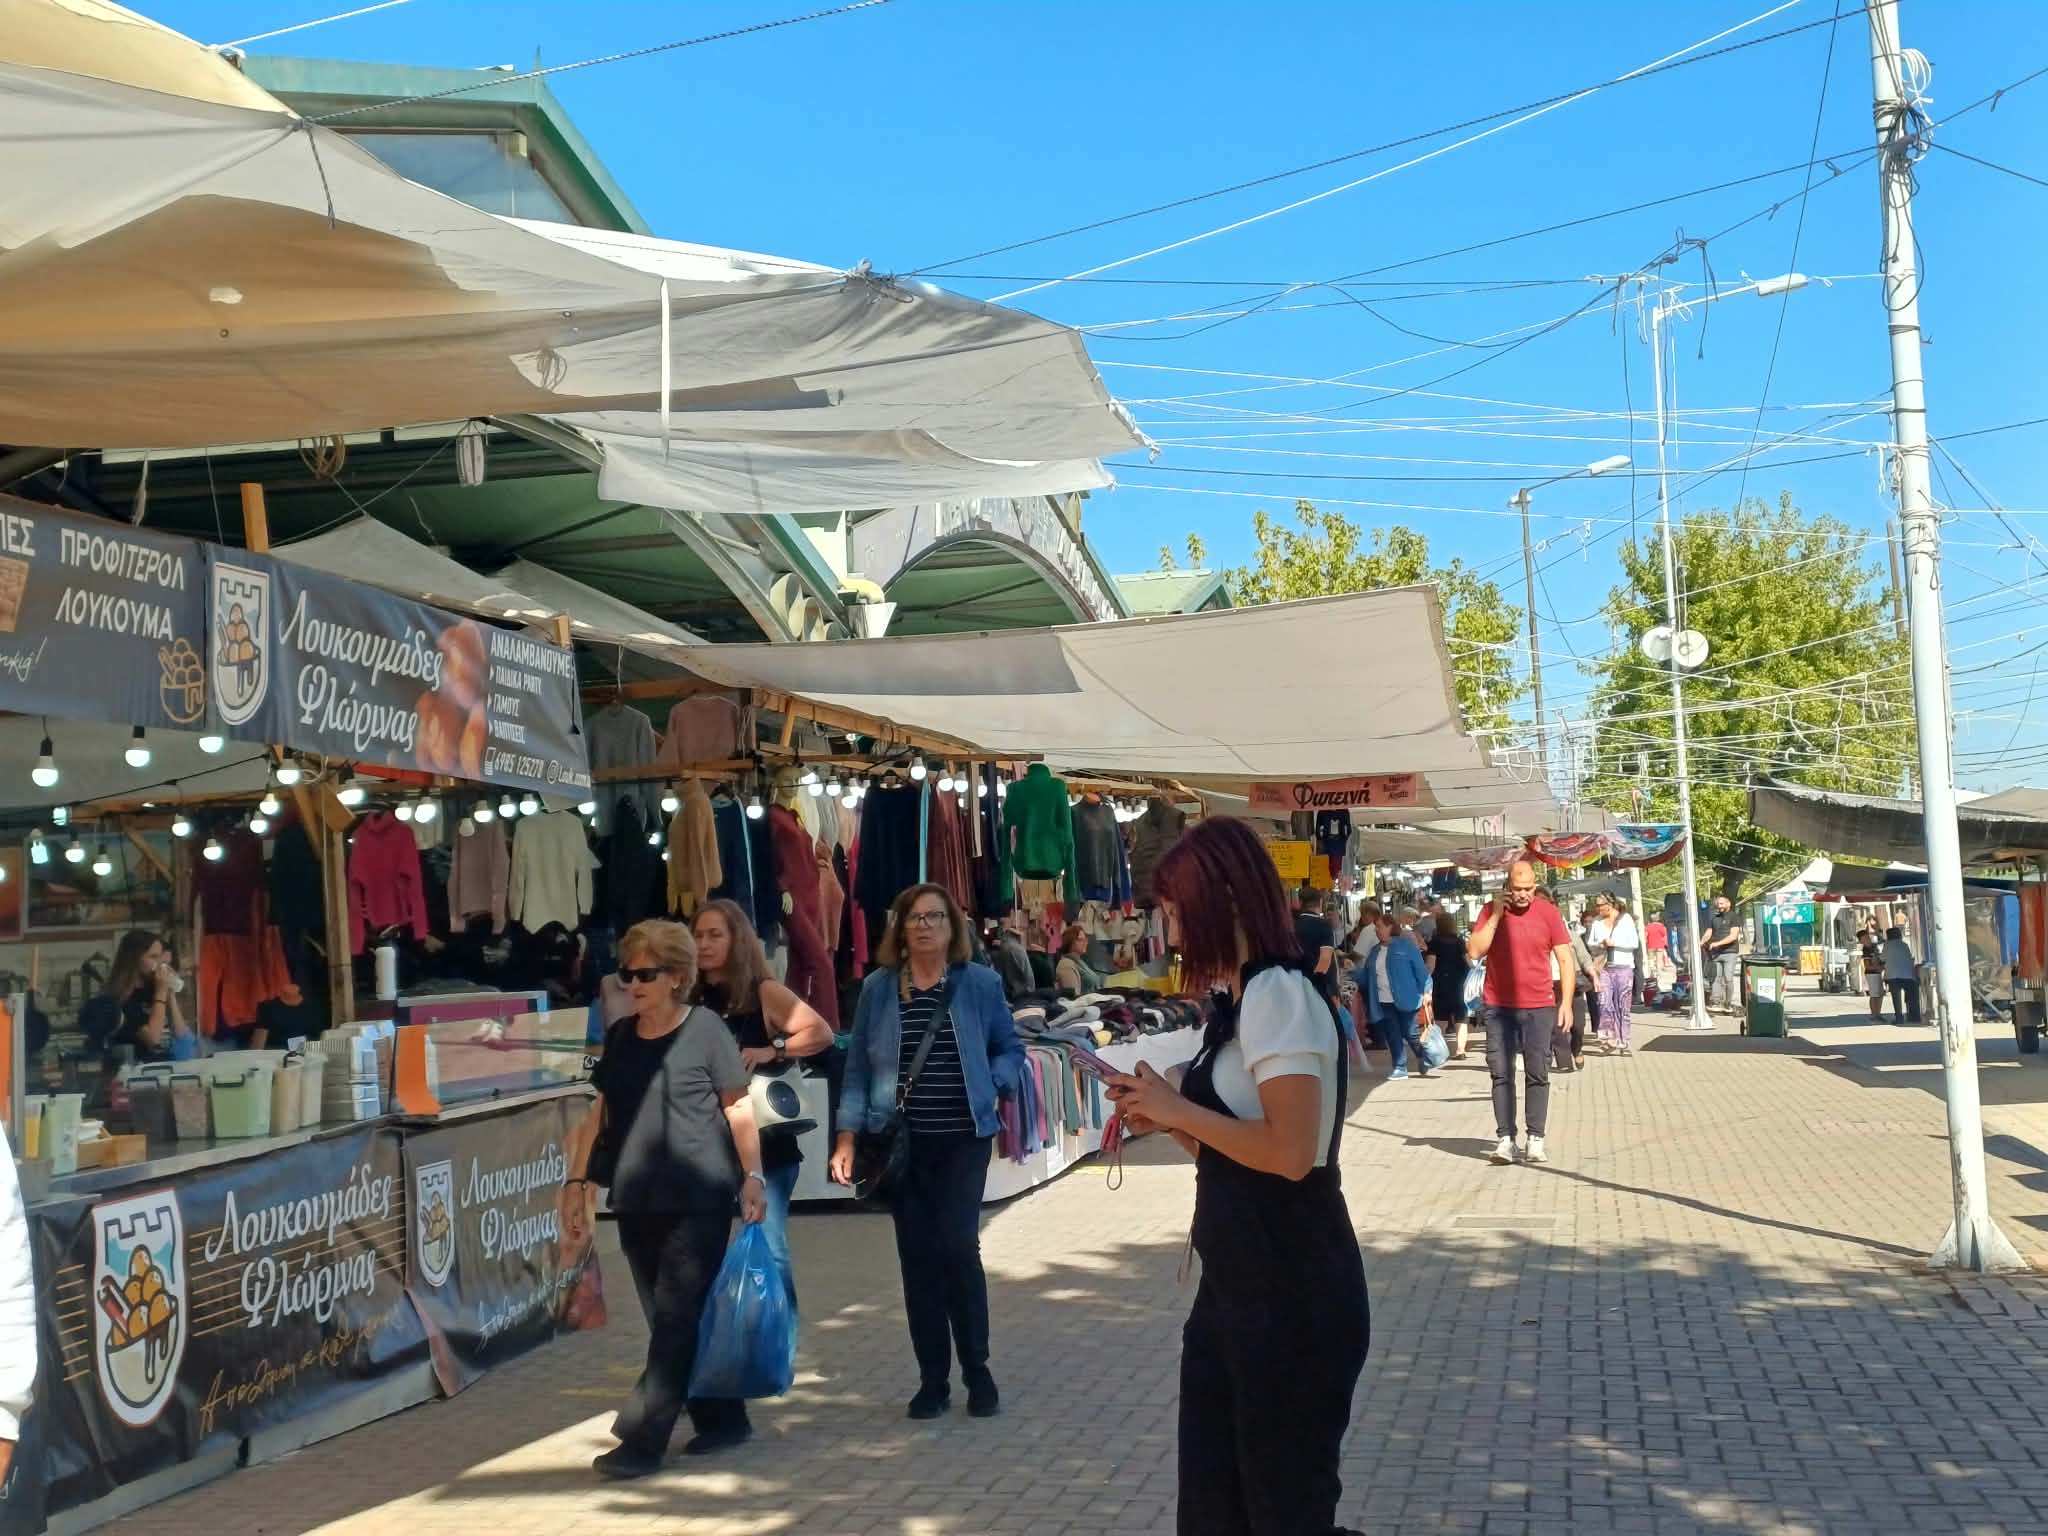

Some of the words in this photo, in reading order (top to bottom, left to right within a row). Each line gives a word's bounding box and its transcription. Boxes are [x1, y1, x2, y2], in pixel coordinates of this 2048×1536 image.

[60, 527, 185, 591] ΠΡΟΦΙΤΕΡΟΛ
[55, 586, 174, 641] ΛΟΥΚΟΥΜΑ
[279, 589, 443, 692] Λουκουμάδες
[297, 664, 418, 752] Φλώρινας
[1292, 781, 1371, 809] Φωτεινή
[461, 1144, 567, 1209] Λουκουμάδες
[204, 1163, 394, 1263] Λουκουμάδες
[481, 1207, 558, 1261] Φλώρινας
[241, 1249, 377, 1329] Φλώρινας
